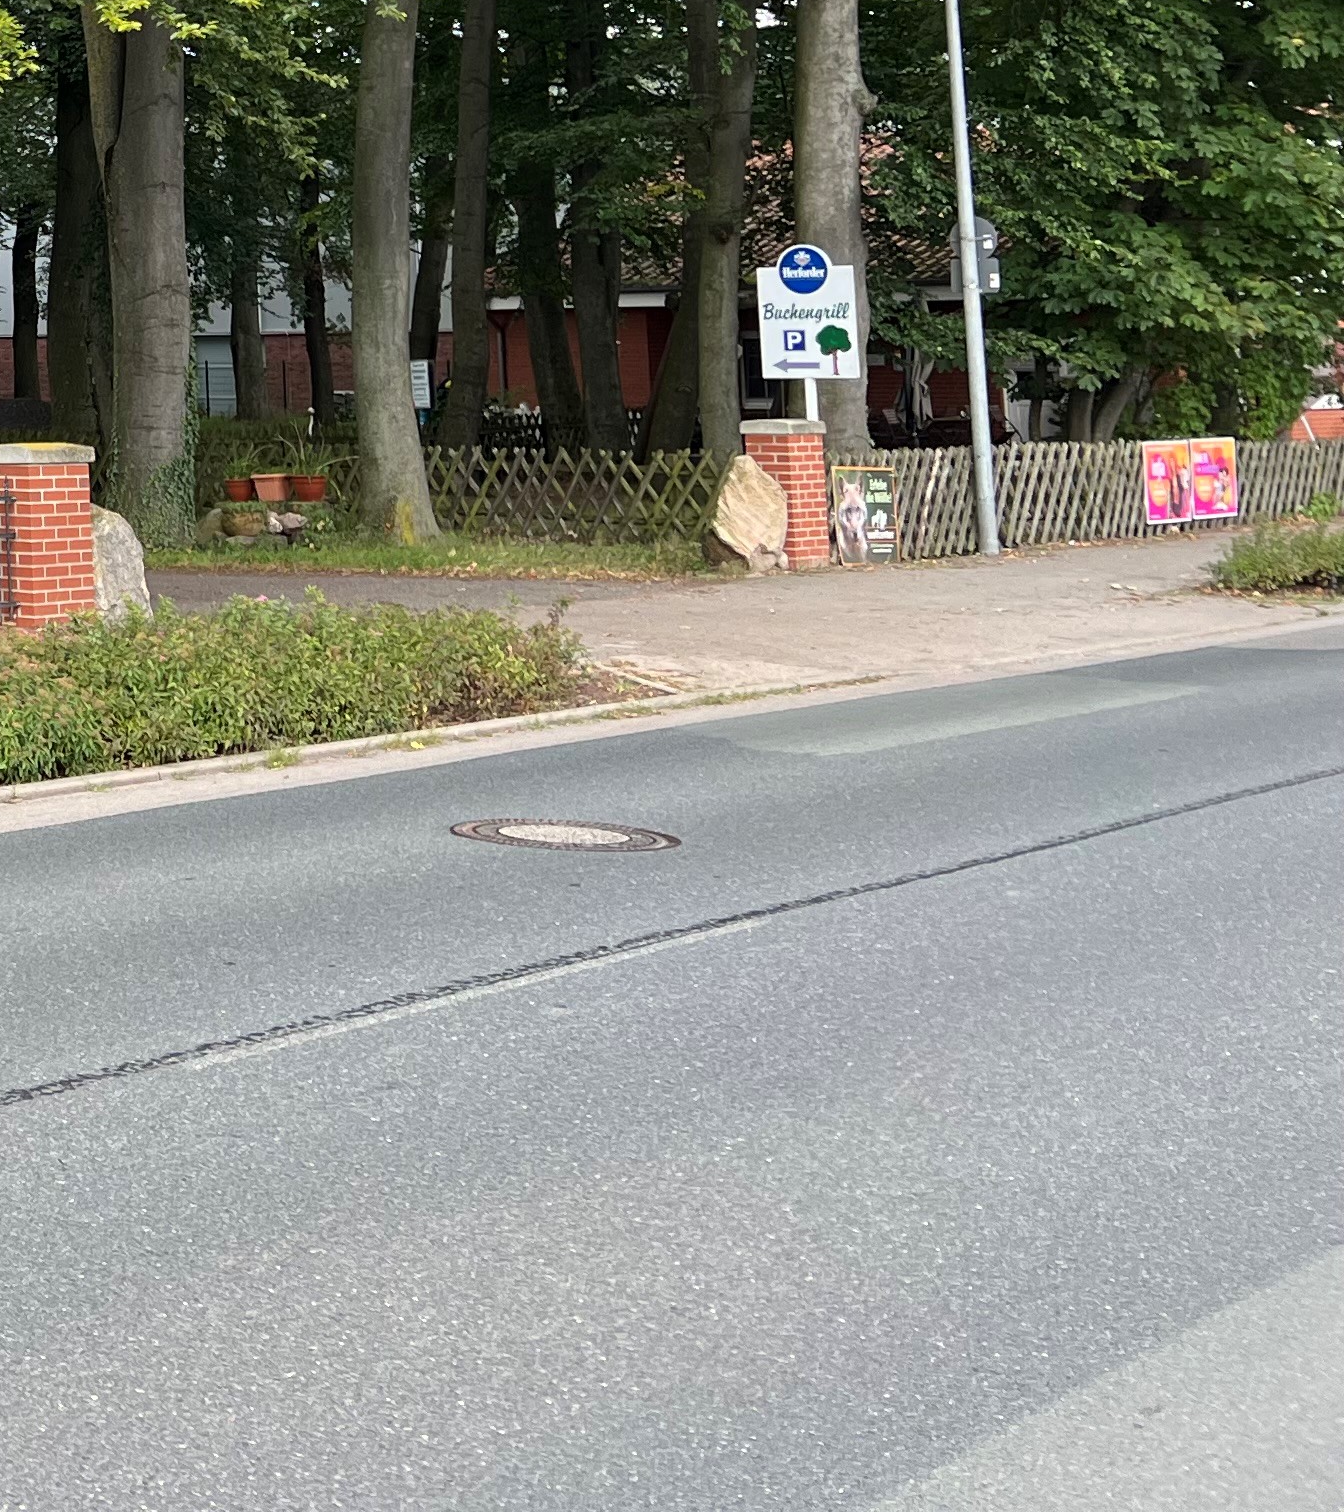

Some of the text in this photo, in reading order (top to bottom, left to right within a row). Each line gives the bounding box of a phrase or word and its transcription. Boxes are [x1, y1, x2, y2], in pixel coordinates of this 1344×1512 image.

[782, 266, 825, 278] Herforder
[762, 302, 850, 323] Buchengrill
[786, 331, 803, 350] P
